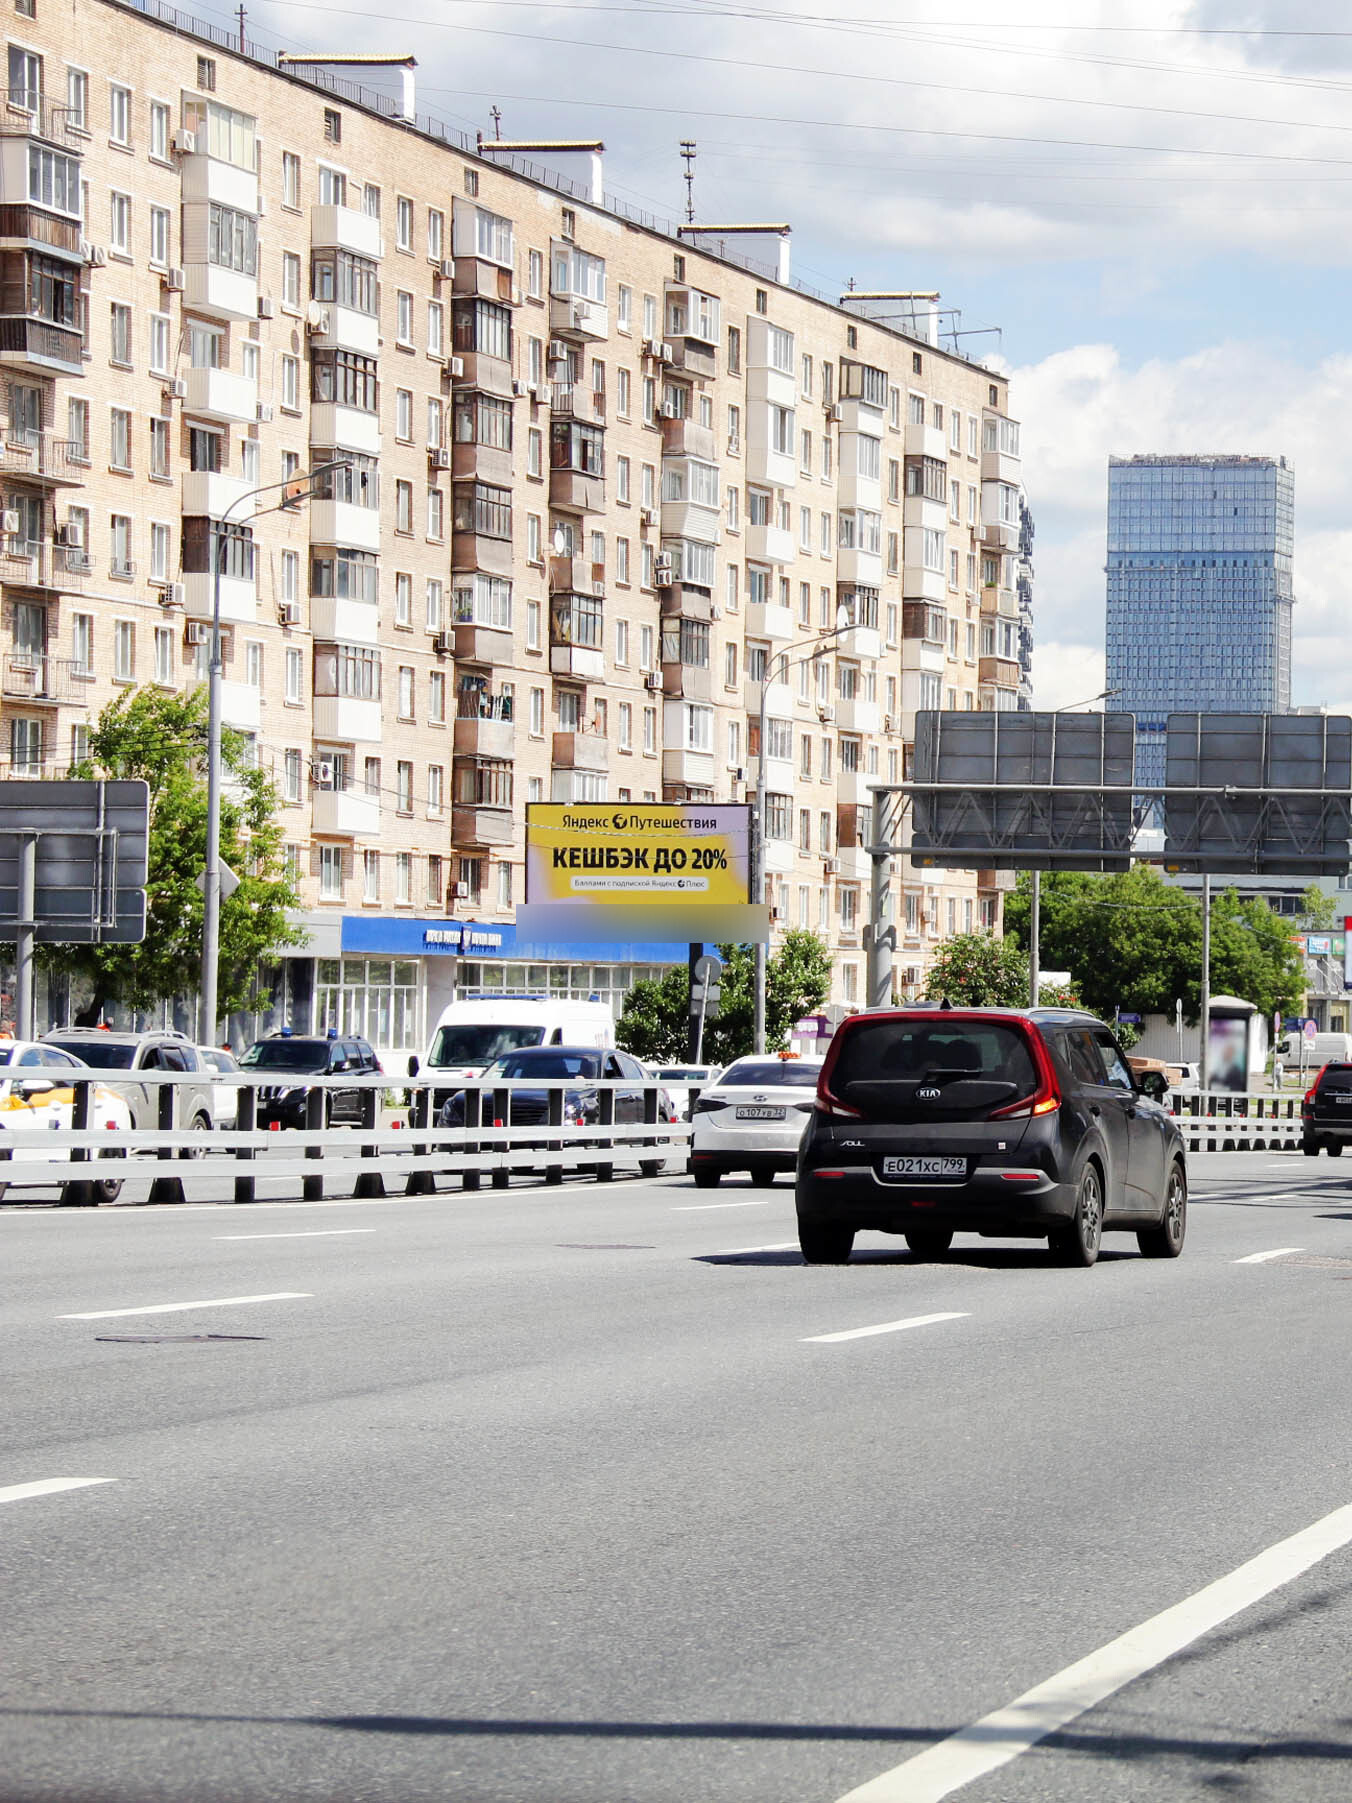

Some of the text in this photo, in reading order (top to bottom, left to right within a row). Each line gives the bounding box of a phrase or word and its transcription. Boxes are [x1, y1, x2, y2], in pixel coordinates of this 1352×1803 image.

[562, 814, 717, 831] Яндекс Путешествия
[552, 847, 728, 874] КЕШБЭК ДО 20%
[919, 1089, 937, 1098] KIA
[943, 1158, 964, 1170] 799
